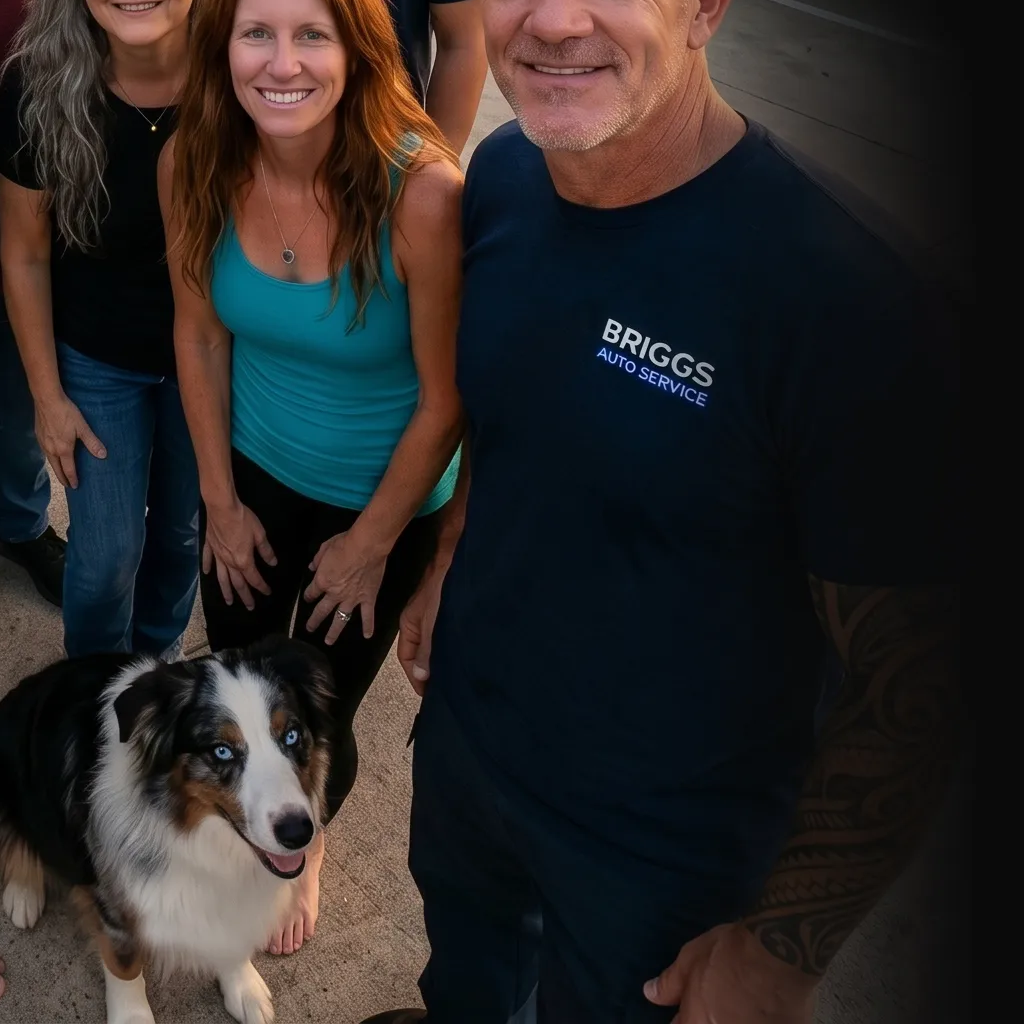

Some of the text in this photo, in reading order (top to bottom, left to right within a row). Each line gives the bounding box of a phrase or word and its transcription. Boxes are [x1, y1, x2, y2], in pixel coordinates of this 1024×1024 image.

[596, 347, 708, 407] AUTO SERVICE
[602, 318, 715, 387] BRIGGS
